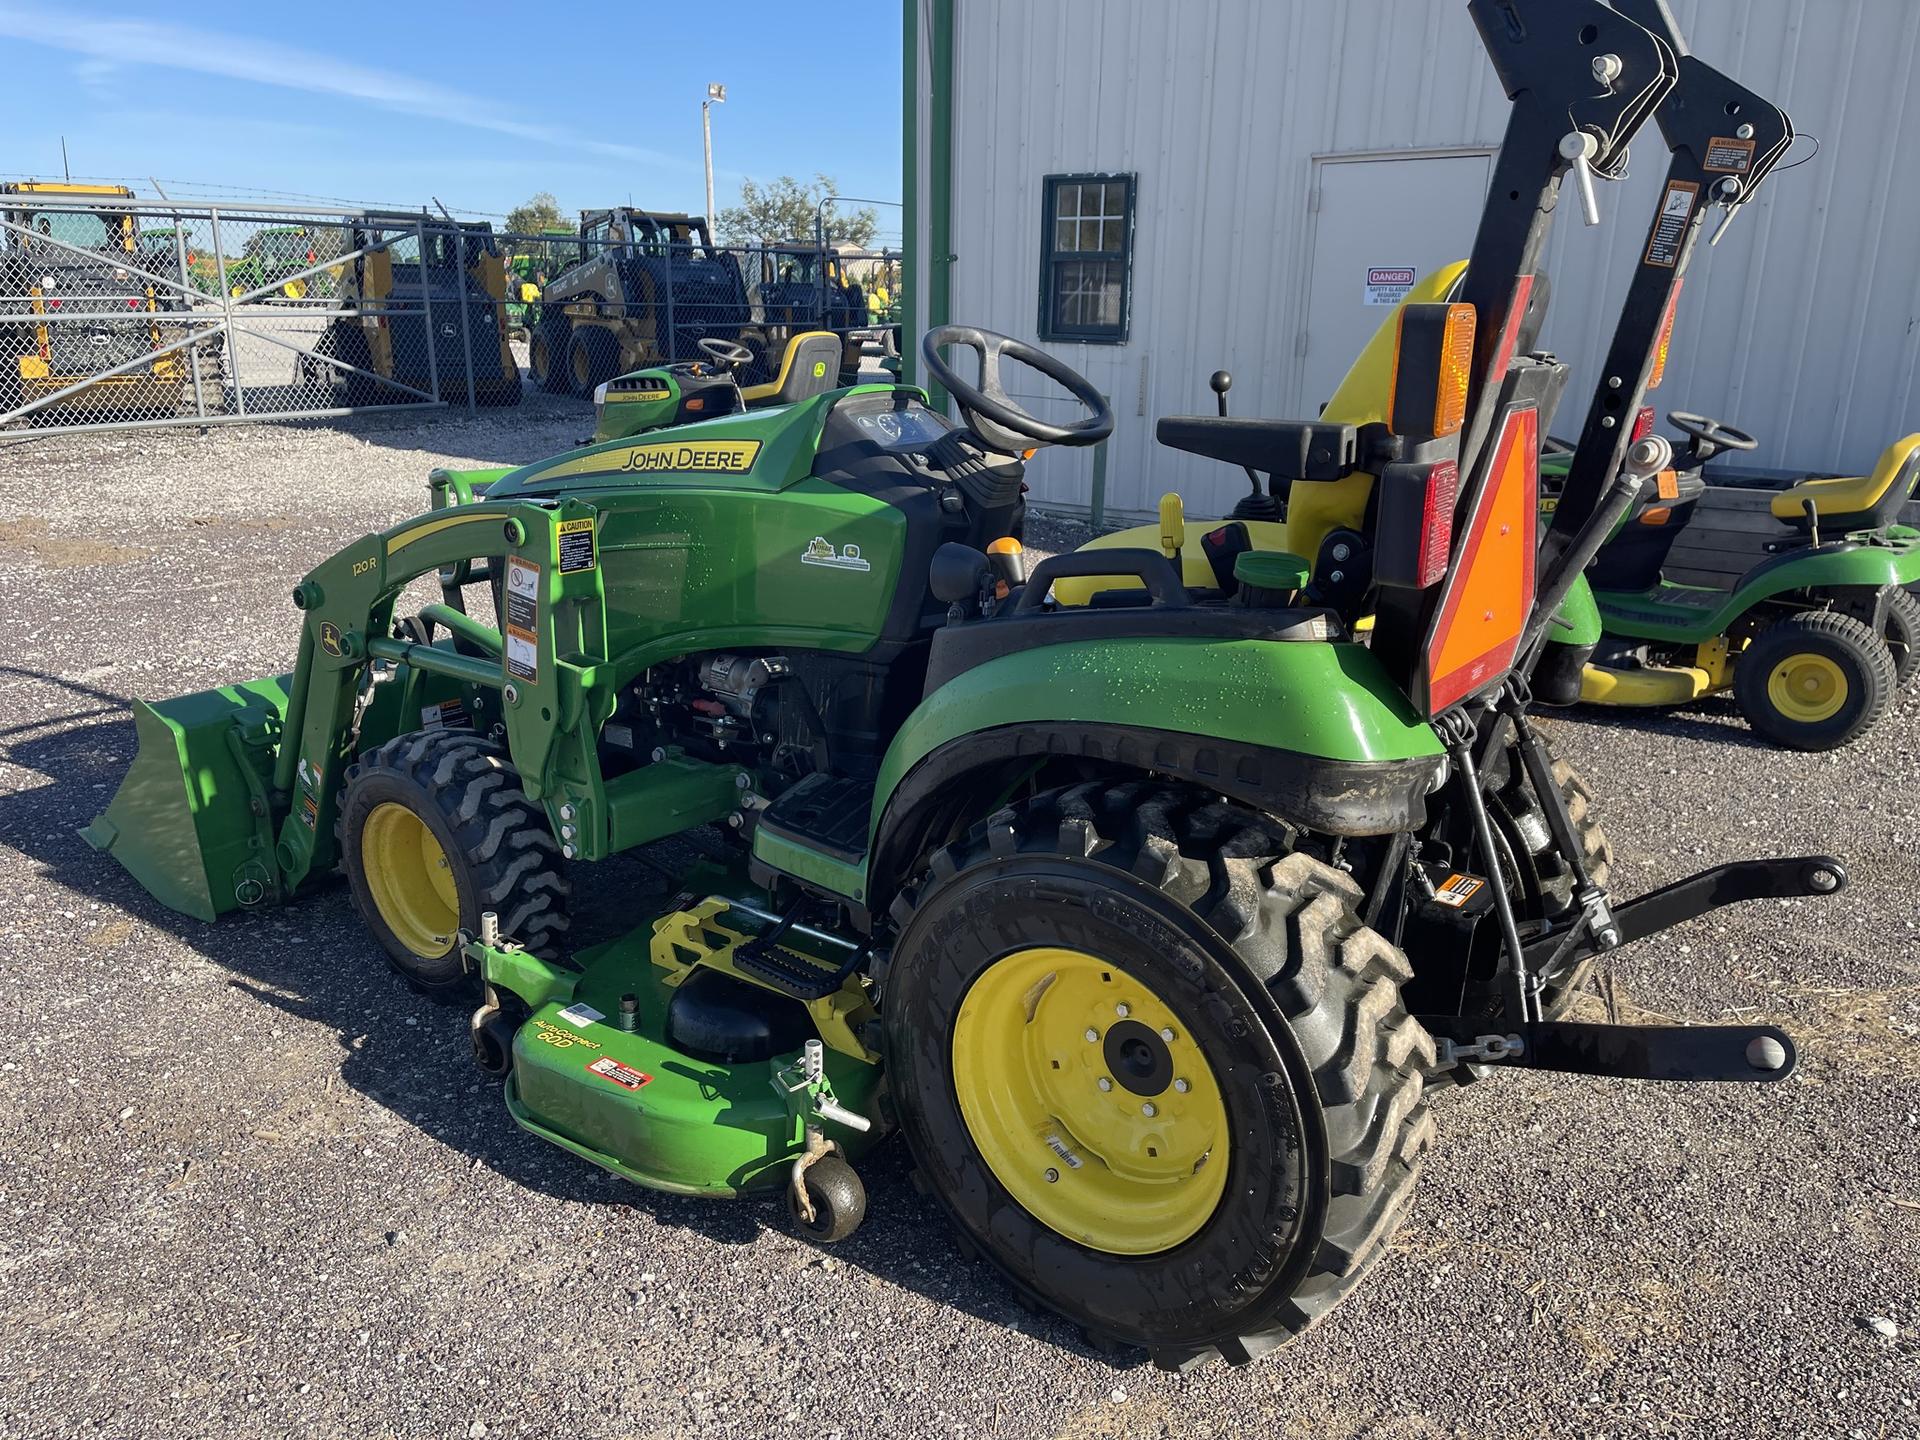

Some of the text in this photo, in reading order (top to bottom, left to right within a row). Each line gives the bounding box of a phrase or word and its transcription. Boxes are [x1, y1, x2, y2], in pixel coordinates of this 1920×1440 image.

[1372, 272, 1410, 281] DANGER
[622, 448, 745, 469] JOHN DEERE
[566, 520, 593, 531] CAUTION
[352, 557, 377, 577] 120 R
[531, 1019, 602, 1050] AutoConnect
[536, 1031, 574, 1048] 60D
